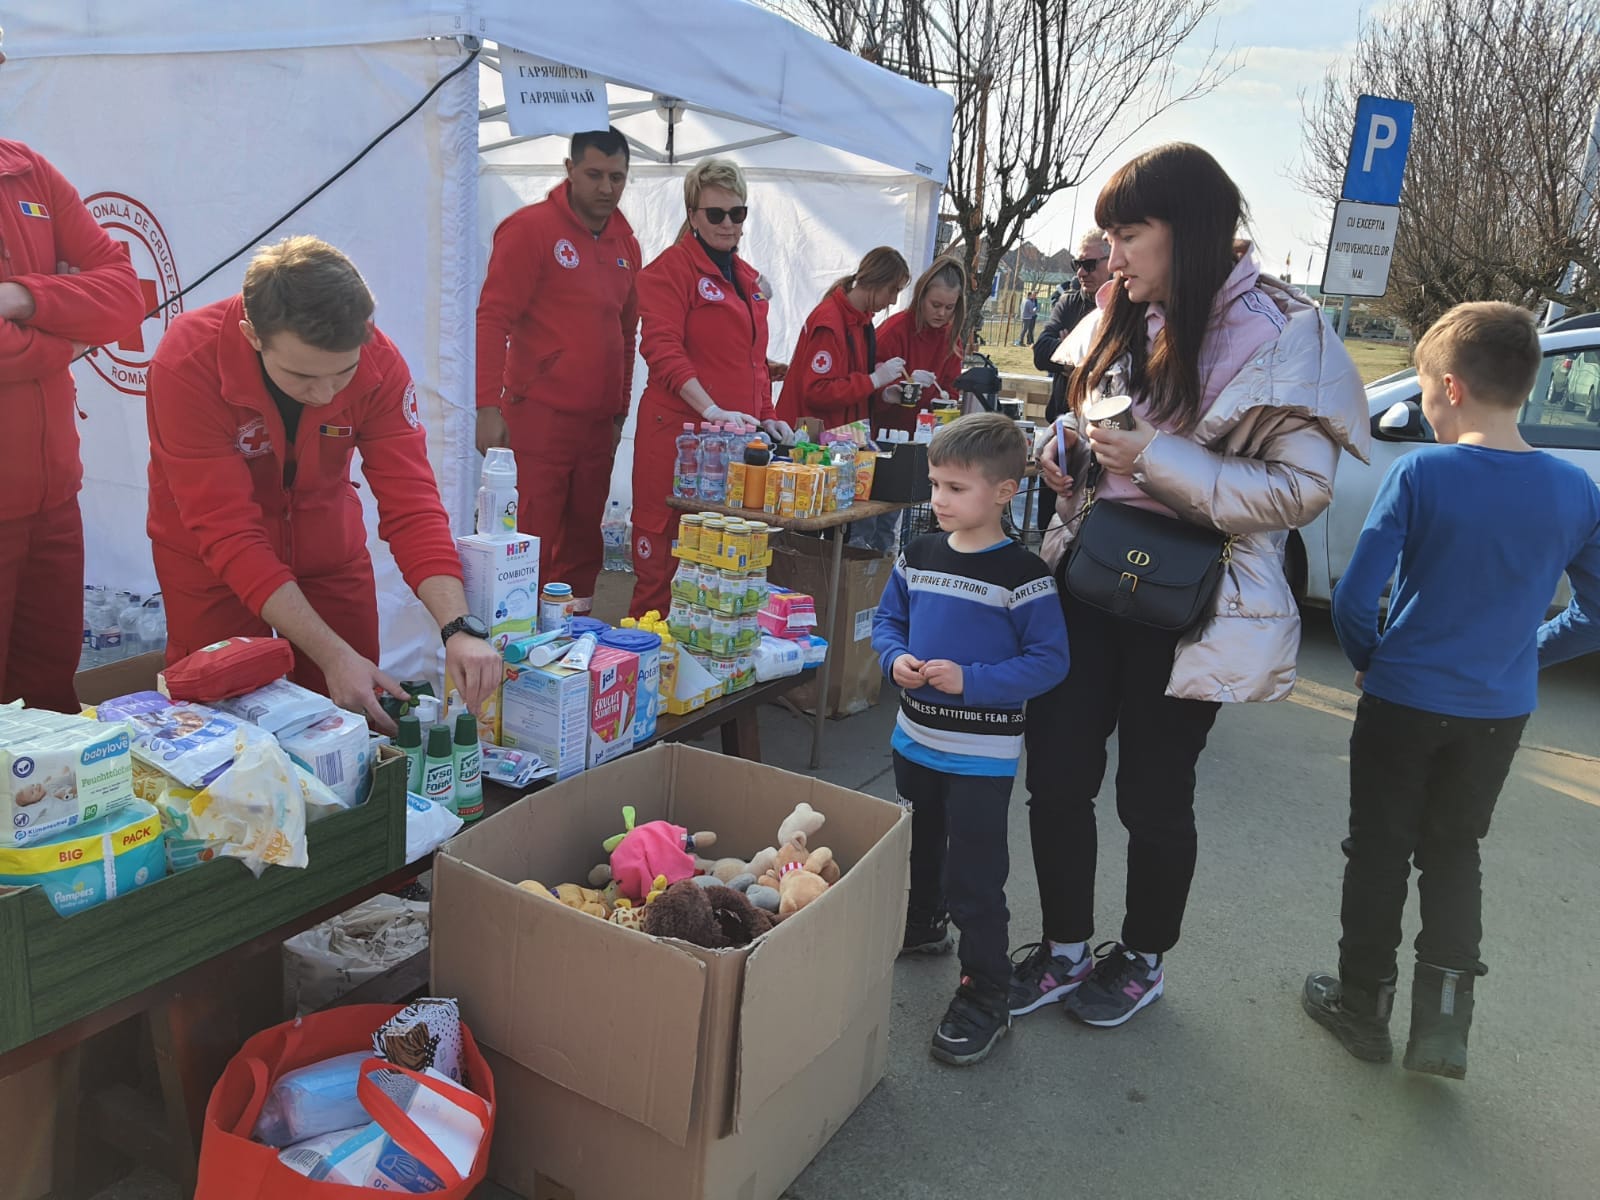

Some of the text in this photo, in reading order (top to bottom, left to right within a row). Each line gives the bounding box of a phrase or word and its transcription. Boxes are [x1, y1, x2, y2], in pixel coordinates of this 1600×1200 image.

[571, 88, 595, 103] ЧАЙ
[1362, 113, 1398, 172] P
[1347, 216, 1356, 227] CU
[134, 212, 149, 232] DE
[150, 230, 175, 285] CRUCE
[1334, 242, 1390, 257] AUTOVEHICULELOR
[1352, 268, 1363, 279] MAI
[112, 366, 147, 386] ROMÂ
[498, 566, 536, 582] COMBIOTIK
[941, 577, 951, 588] BE
[952, 579, 988, 596] STRONG
[939, 708, 982, 721] ATTITUDE
[83, 740, 129, 761] babylove
[427, 768, 453, 783] LYSO
[59, 826, 152, 863] BIG PACK
[54, 887, 95, 904] Pampers
